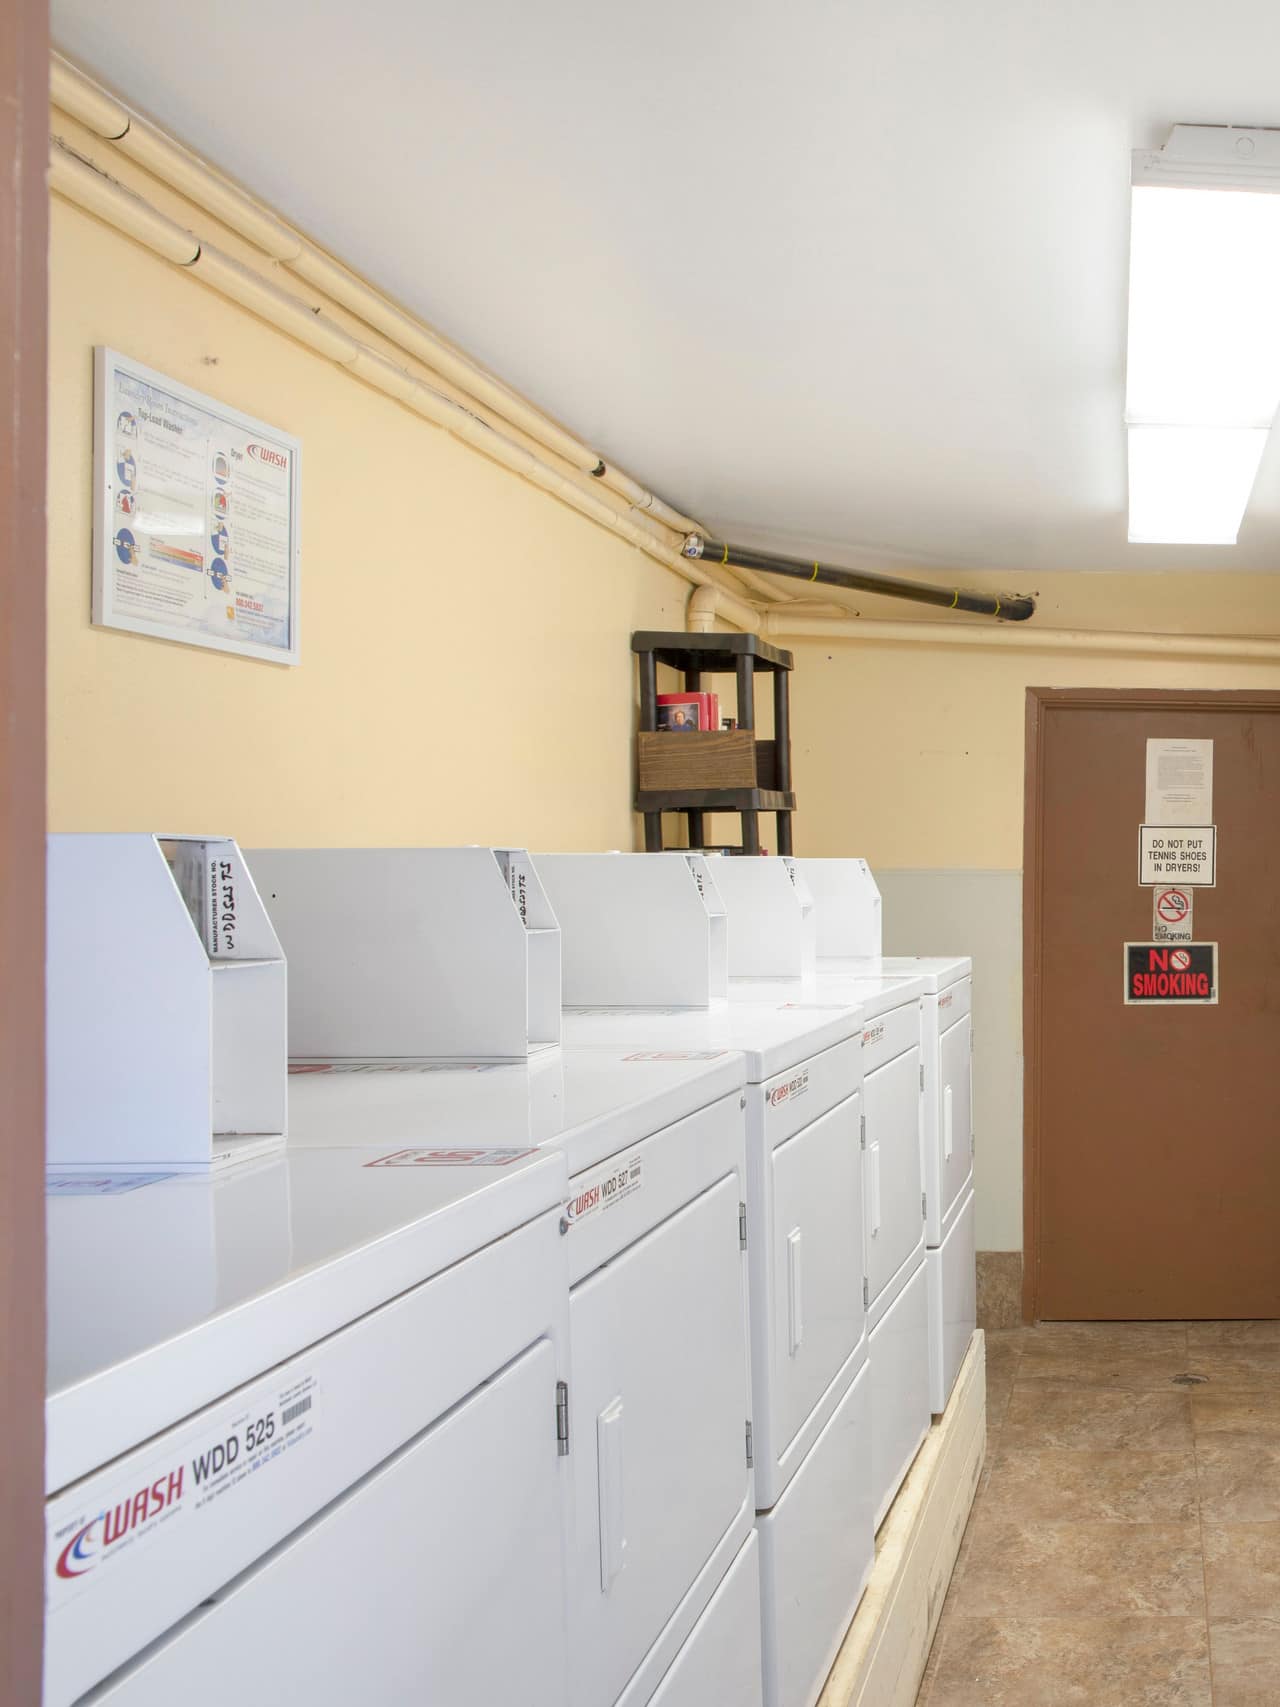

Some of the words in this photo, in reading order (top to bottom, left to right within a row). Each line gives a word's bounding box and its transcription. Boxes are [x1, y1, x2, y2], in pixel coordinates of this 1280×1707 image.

[260, 447, 288, 469] WASH
[1152, 839, 1164, 849] DO
[1167, 839, 1184, 849] NOT
[1187, 839, 1203, 849] PUT
[1148, 851, 1177, 860] TENNIS
[1180, 851, 1207, 861] SHOES
[1154, 863, 1162, 872] IN
[1165, 863, 1201, 873] DRYERS!
[1155, 925, 1168, 933] NO
[1155, 932, 1191, 940] SMOKING
[1133, 973, 1209, 997] SMOKING
[575, 1184, 600, 1215] WASH
[103, 1465, 184, 1546] WASH
[192, 1435, 239, 1486] WDD
[245, 1412, 275, 1452] 525
